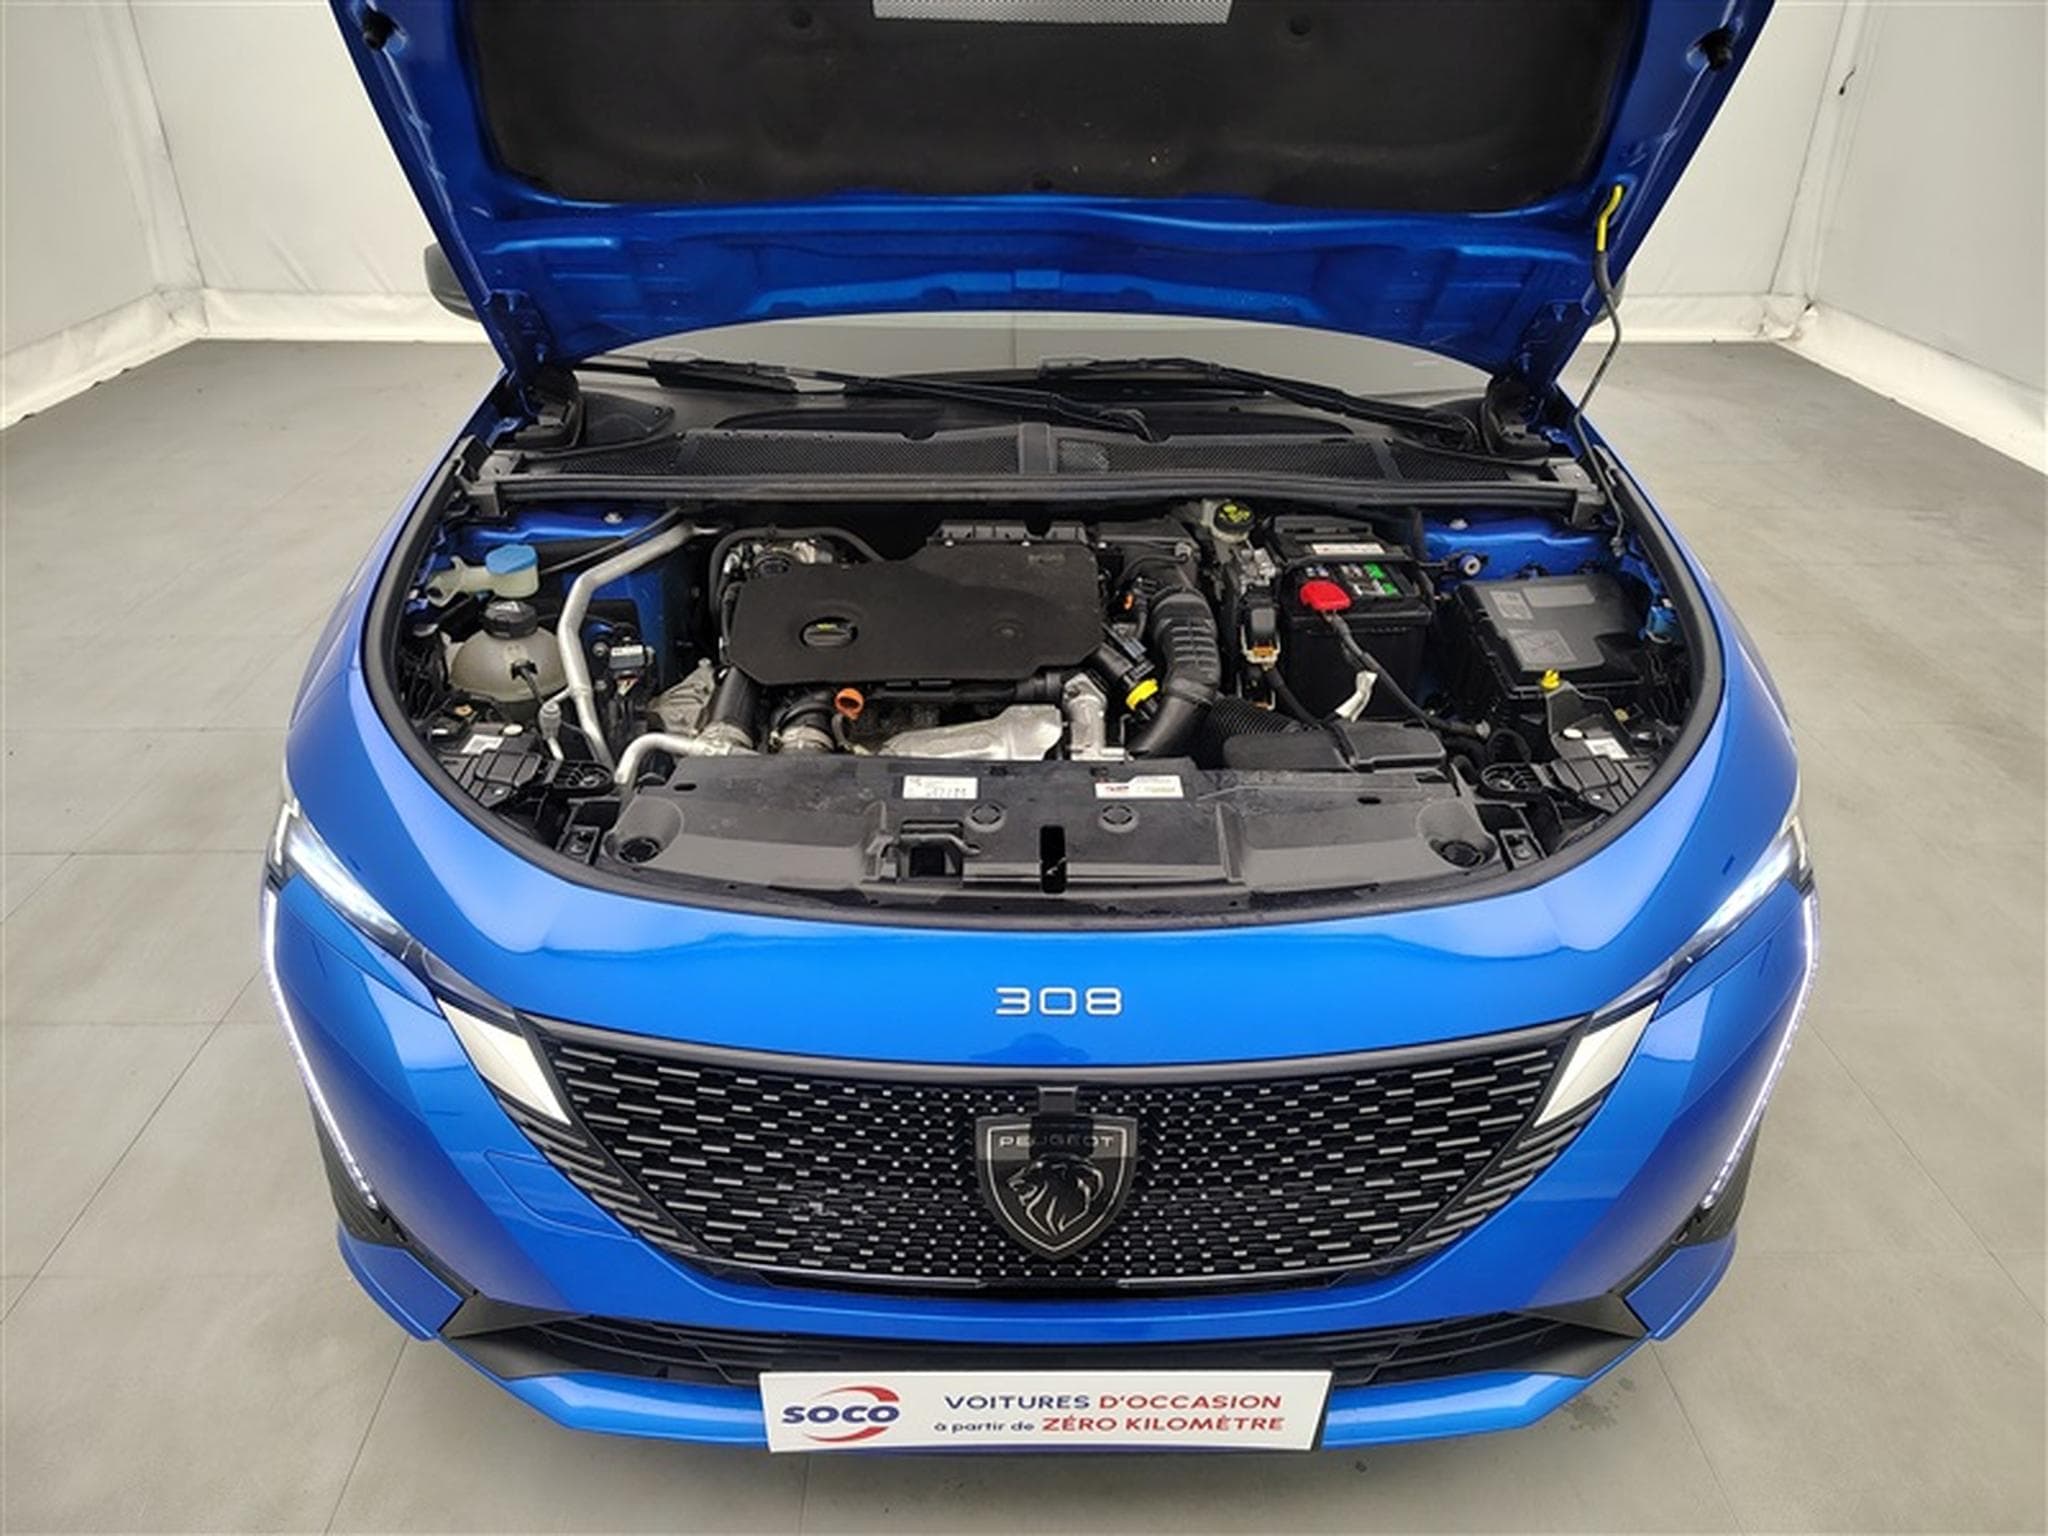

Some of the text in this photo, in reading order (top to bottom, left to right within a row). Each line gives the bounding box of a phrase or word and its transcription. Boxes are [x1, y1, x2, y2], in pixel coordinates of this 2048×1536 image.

[995, 987, 1121, 1015] 308
[945, 1395, 1281, 1409] VOITURES D'OCCASION
[782, 1405, 900, 1423] SOCO
[952, 1421, 1005, 1434] partir
[1011, 1421, 1035, 1431] de
[1043, 1414, 1117, 1431] ZÉRO
[1126, 1414, 1285, 1431] KILOMÈTRE
